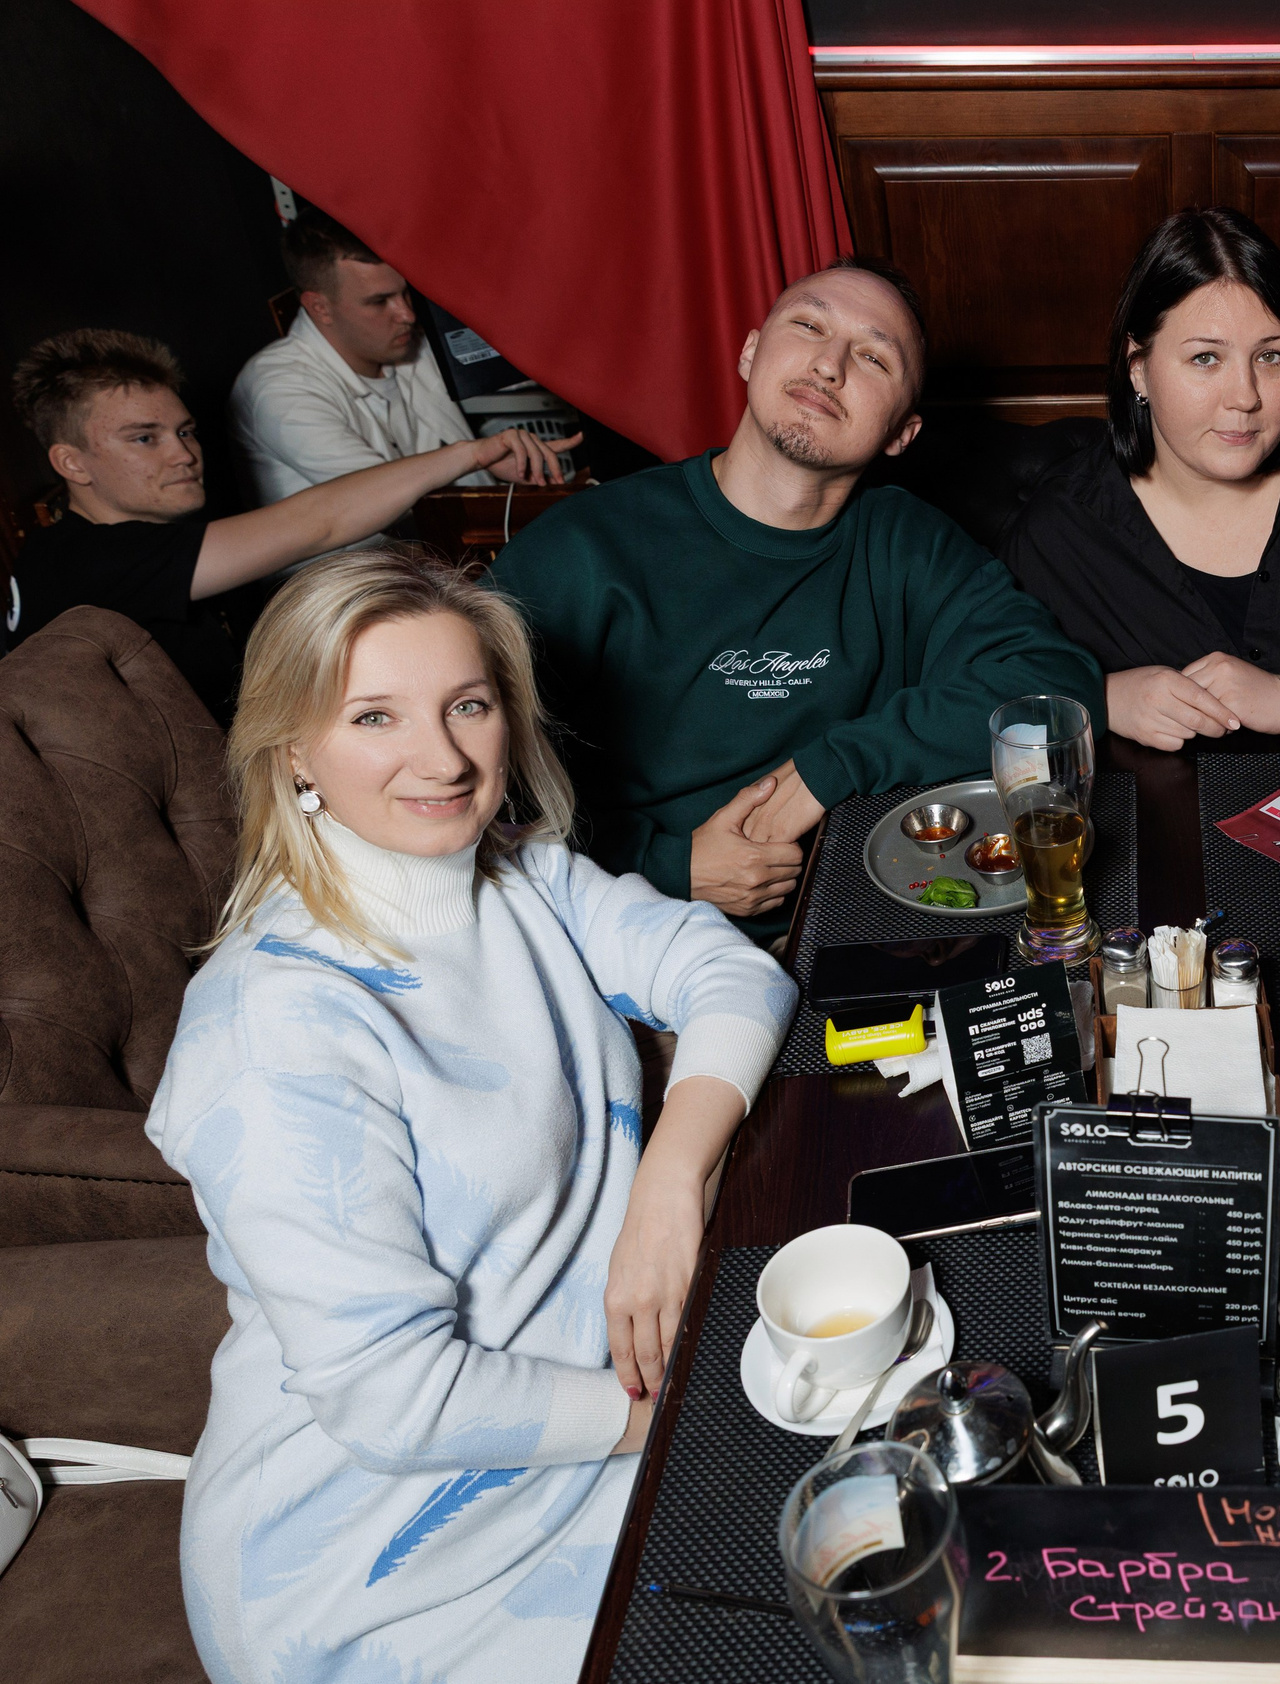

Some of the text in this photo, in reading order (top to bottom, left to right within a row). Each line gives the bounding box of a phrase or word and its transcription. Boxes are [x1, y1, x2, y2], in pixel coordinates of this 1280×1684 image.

[708, 649, 831, 679] Los Angeles
[725, 678, 758, 686] BEVERLY
[985, 977, 1016, 993] SOLO
[969, 1002, 1003, 1014] ПРОГРАММА
[1002, 992, 1039, 1007] ЛОЯЛЬНОСТИ
[980, 1017, 1007, 1028] СКАЧАЙТЕ
[1017, 1008, 1044, 1023] uds
[842, 1029, 869, 1038] BABY!
[980, 1020, 1016, 1033] ПРИЛОЖЕНИЕ
[1060, 1122, 1110, 1138] SOLO
[1057, 1162, 1263, 1182] АВТОРСКИЕ ОСВЕЖАЮЩИЕ НАПИТКИ
[1085, 1190, 1235, 1205] ЛИМОНАДЫ БЕЗАЛКОГОЛЬНЫЕ
[1058, 1201, 1264, 1221] Яблоко-мята-огурец 450 руб.
[1058, 1216, 1264, 1235] Юдзу-грейпфрут-малина 450 руб.
[1059, 1230, 1263, 1249] Черника-клубника-лайм 450 руб.
[1060, 1243, 1162, 1256] Киви-банан-маракуя
[1243, 1253, 1262, 1262] руб.
[1061, 1258, 1262, 1276] Лимон-базилик-имбирь 450 руб.
[1094, 1281, 1228, 1294] КОКТЕЙЛИ БЕЗАЛКОГОЛЬНЫЕ
[1063, 1294, 1098, 1305] Цитрус
[1099, 1297, 1118, 1305] айс
[1064, 1307, 1116, 1317] Черничный
[1117, 1311, 1146, 1319] вечер
[1155, 1379, 1205, 1446] 5
[984, 1550, 1021, 1583] 2.
[1041, 1547, 1250, 1594] Барбра
